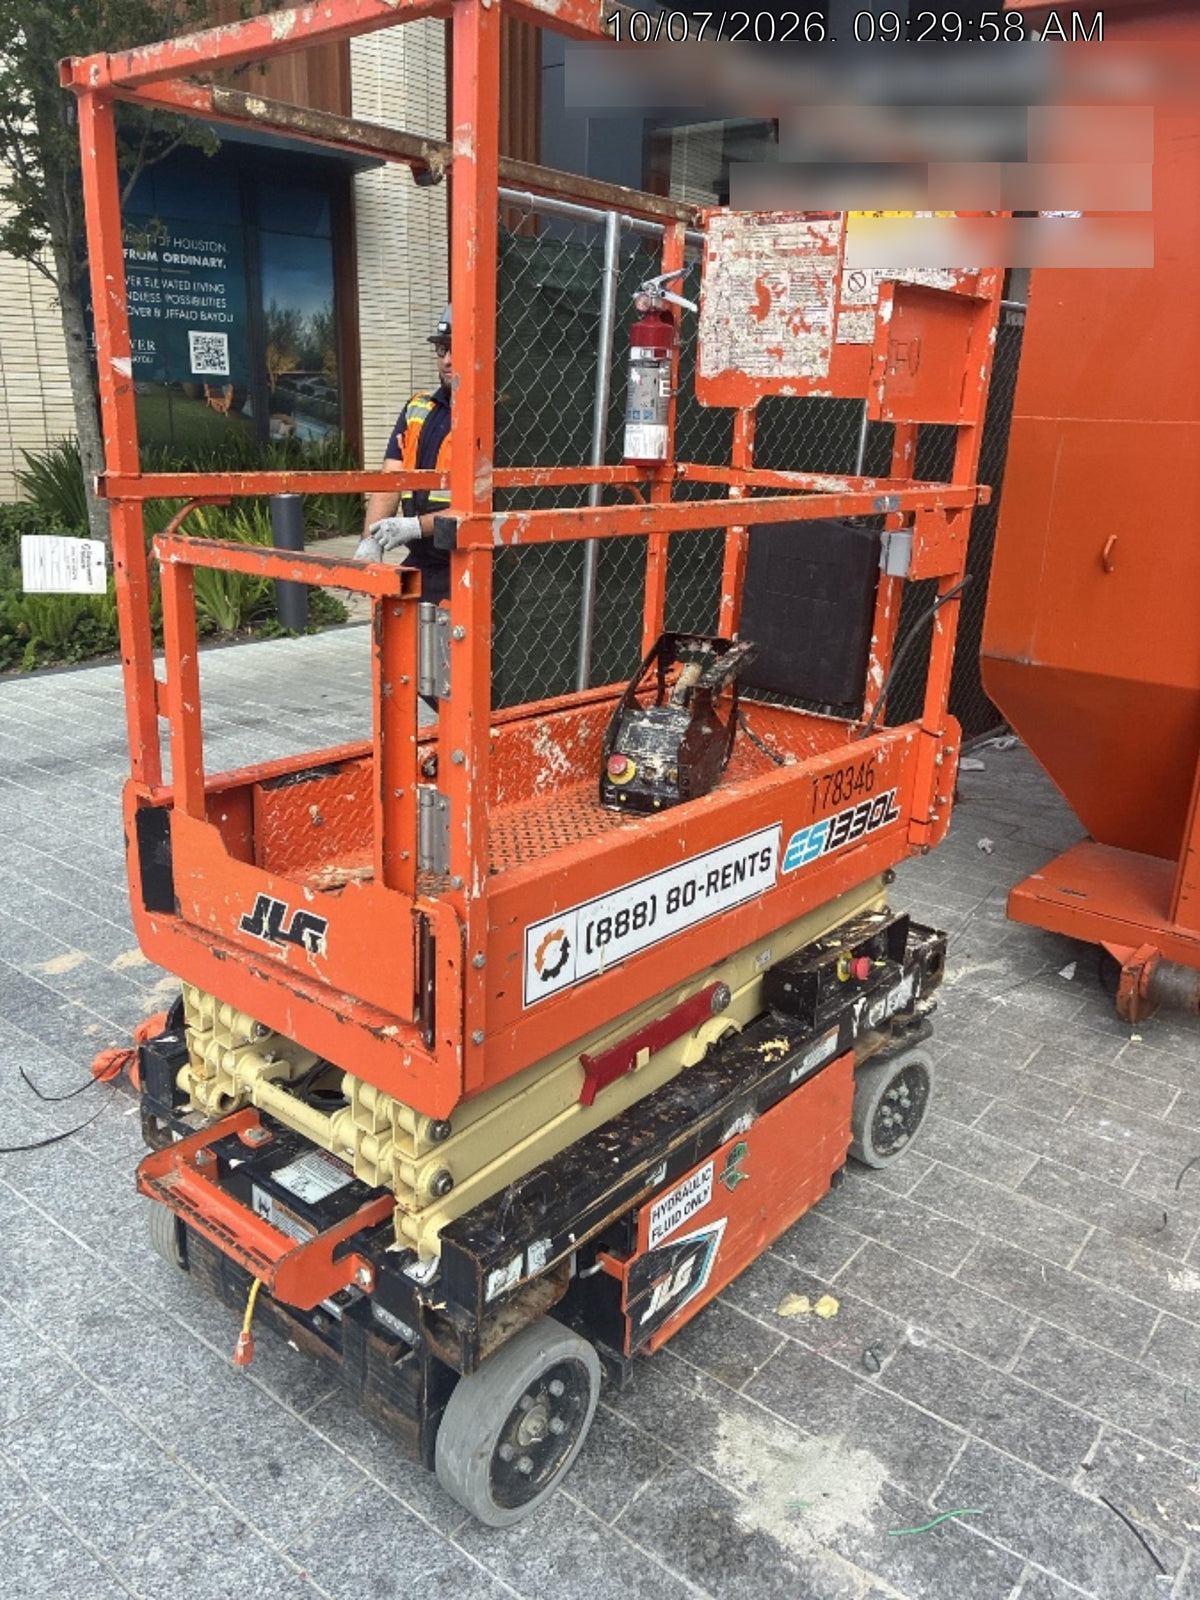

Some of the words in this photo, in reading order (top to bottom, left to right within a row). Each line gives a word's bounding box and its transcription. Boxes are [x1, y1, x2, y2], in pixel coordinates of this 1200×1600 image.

[122, 248, 158, 262] FROM
[125, 290, 162, 304] NDLESS
[165, 294, 227, 309] POSSIBILITIES
[193, 281, 226, 294] LIVING
[811, 756, 876, 816] 178346
[783, 788, 900, 873] ES1330L
[239, 892, 329, 956] JLG
[585, 893, 657, 955] (888)
[665, 846, 772, 915] 80-RENTS
[652, 1167, 712, 1224] HYDRAULIC
[651, 1210, 682, 1243] FLUID
